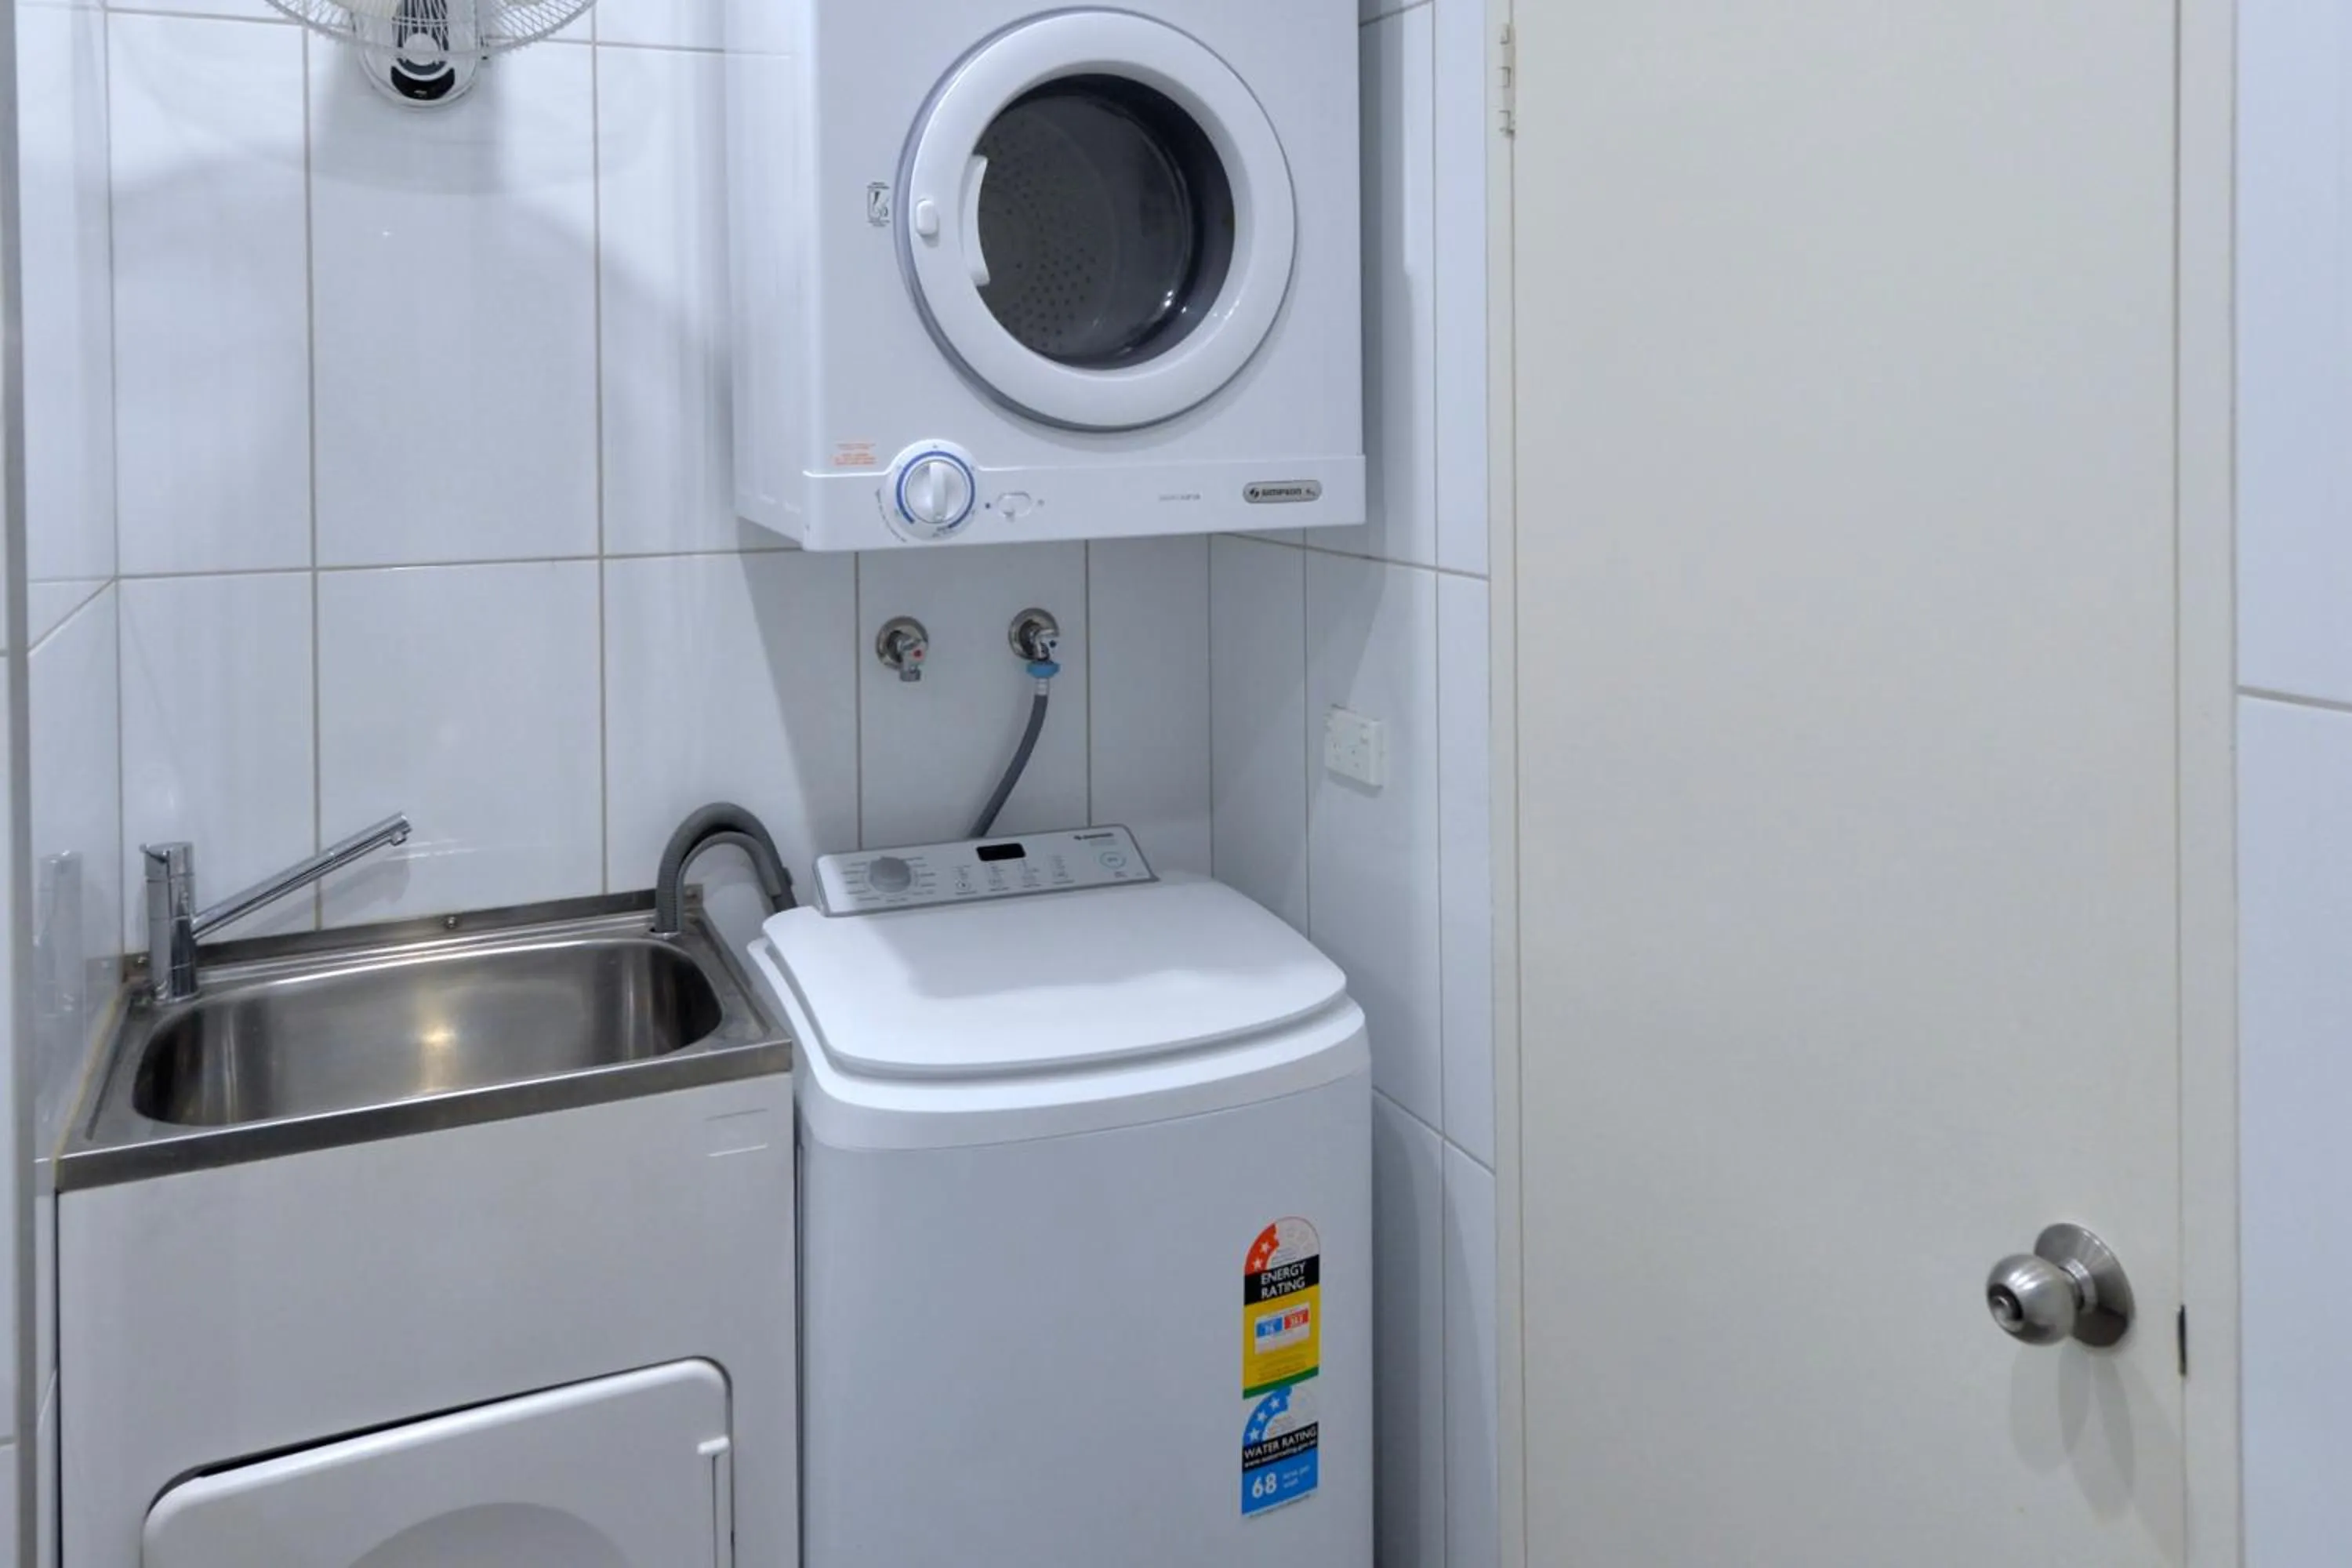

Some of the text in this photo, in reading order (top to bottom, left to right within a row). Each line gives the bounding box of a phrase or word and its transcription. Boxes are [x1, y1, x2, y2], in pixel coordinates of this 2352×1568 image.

[1261, 1261, 1306, 1285] ENERGY
[1261, 1277, 1306, 1300] RATING
[1244, 1439, 1280, 1459] WATER
[1282, 1425, 1316, 1447] RATING
[1252, 1472, 1277, 1498] 68
